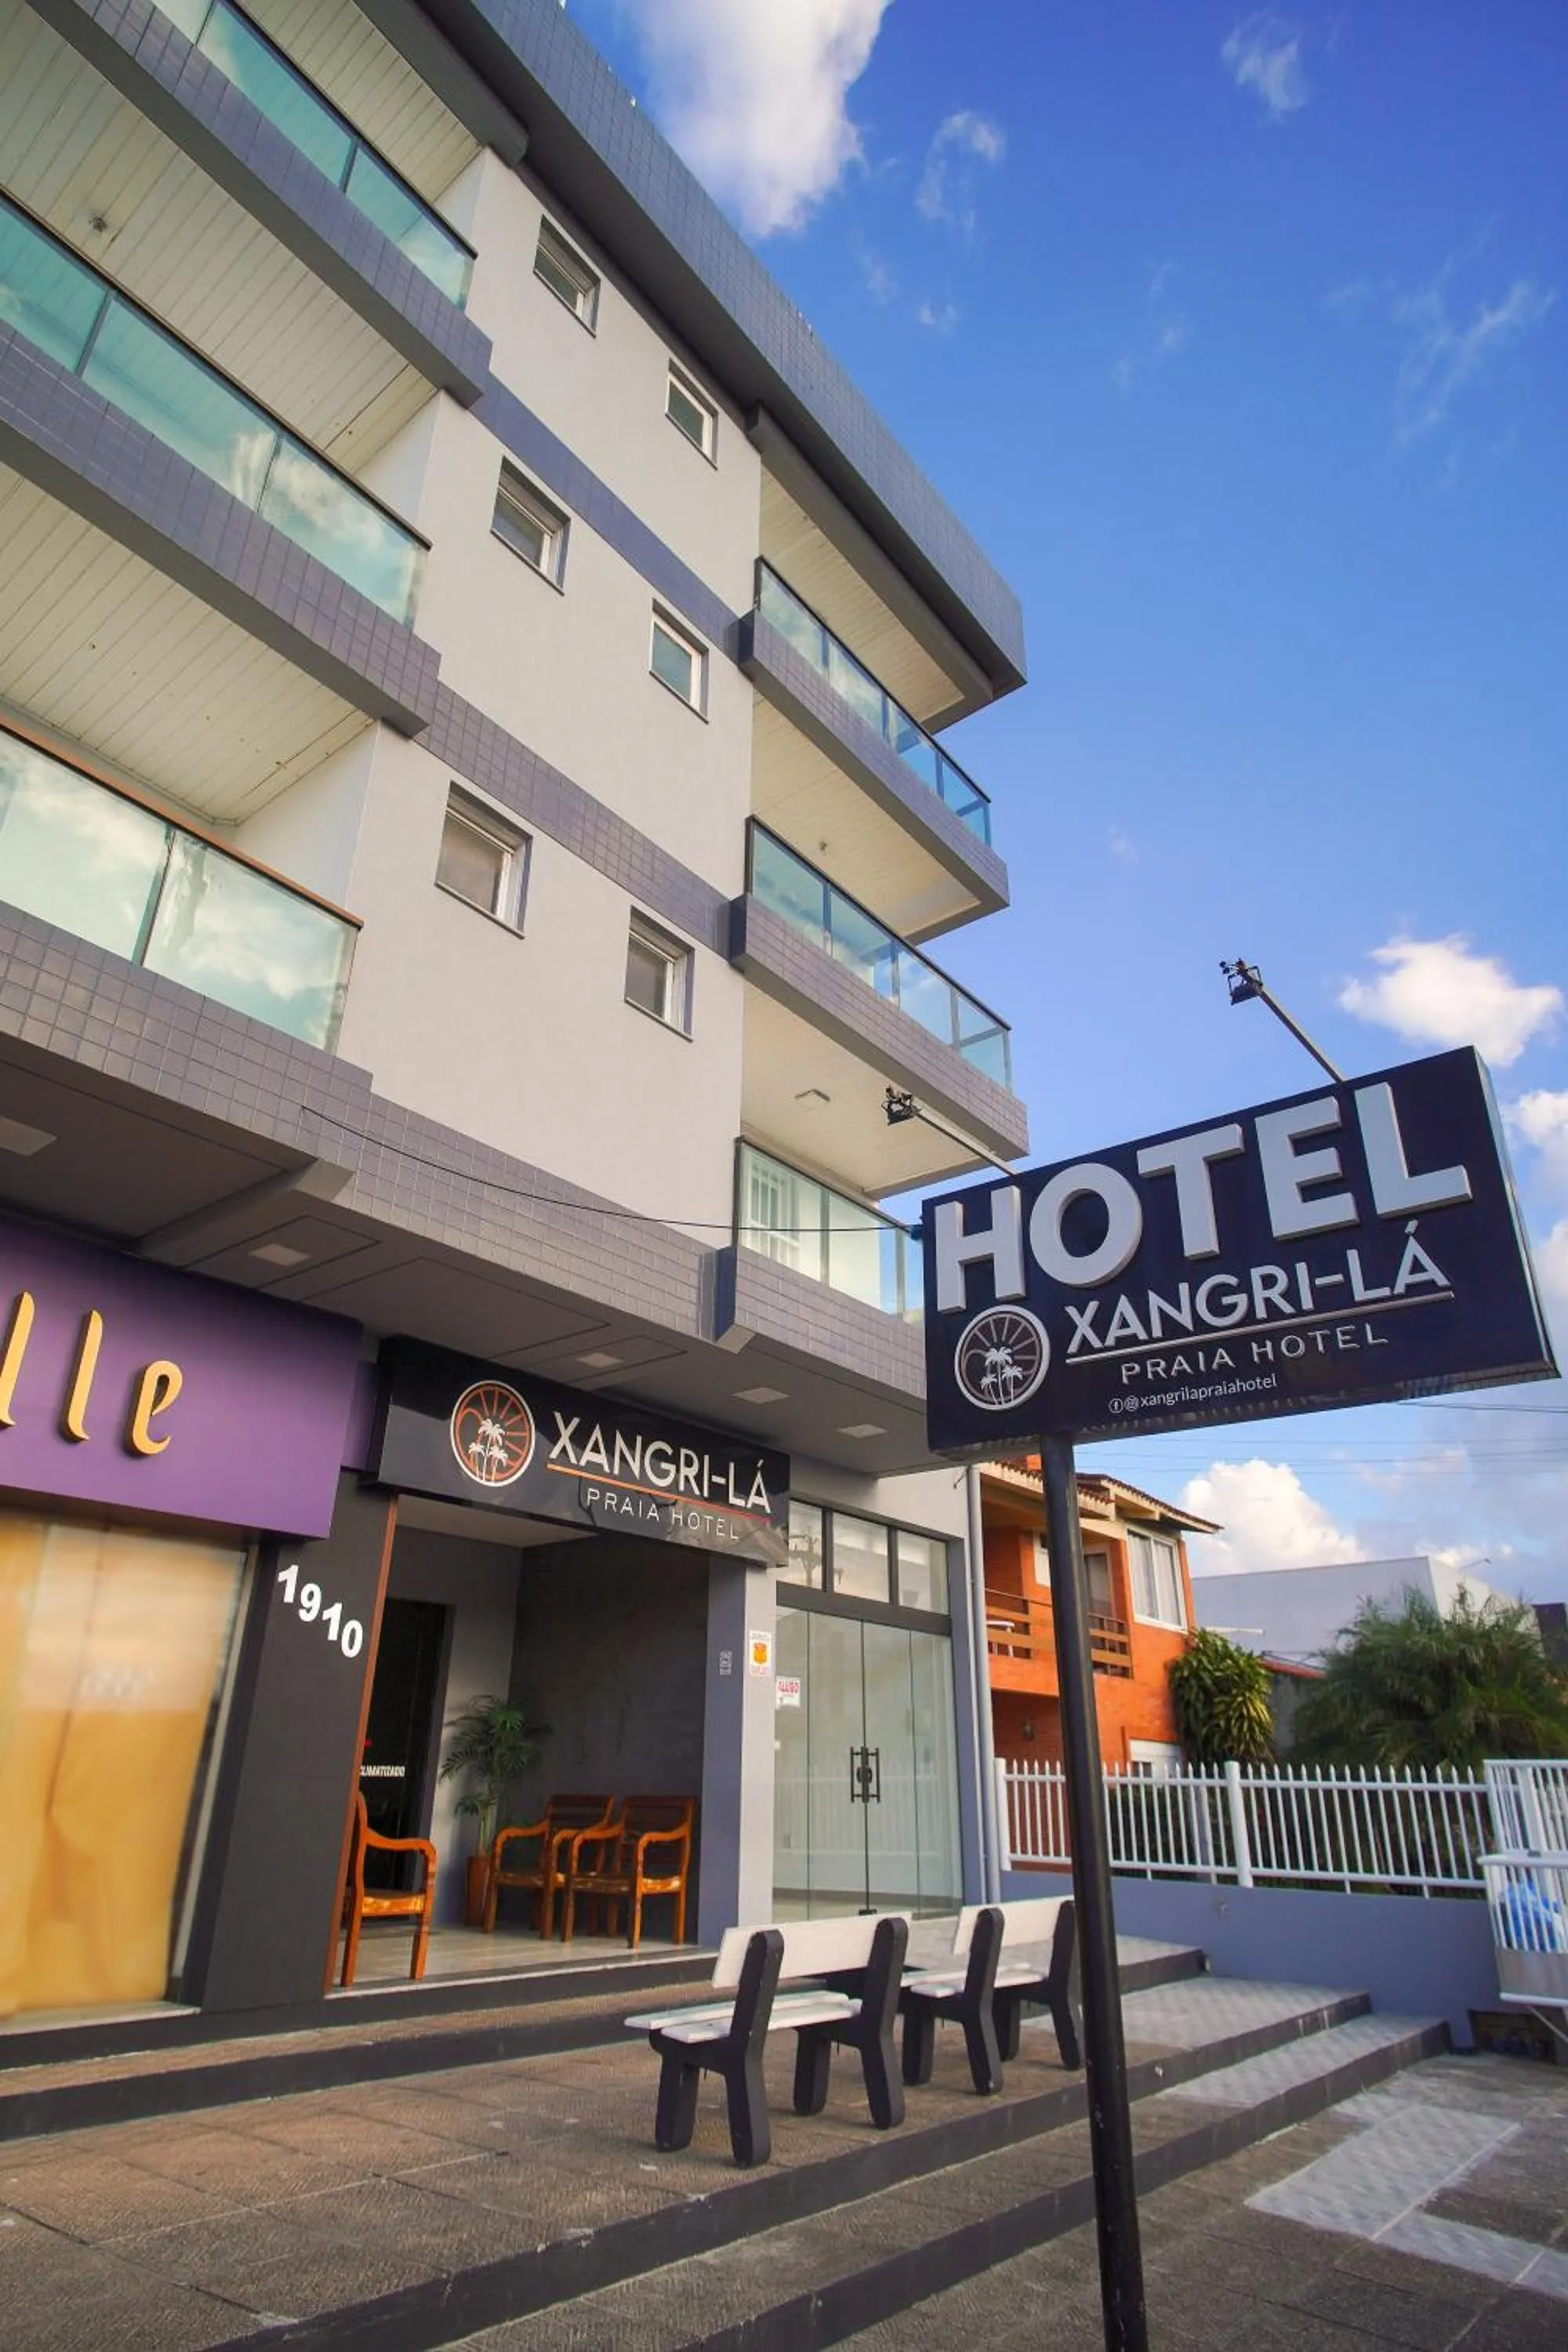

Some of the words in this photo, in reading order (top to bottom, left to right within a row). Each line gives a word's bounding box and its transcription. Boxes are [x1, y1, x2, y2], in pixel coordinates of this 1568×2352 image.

[934, 1082, 1473, 1314] HOTEL
[1065, 1220, 1452, 1355] XANGRI-LÁ
[1120, 1343, 1236, 1385] PRAIA
[1251, 1323, 1389, 1366] HOTEL
[549, 1411, 772, 1514] XANGRI-LÁ
[586, 1487, 661, 1523] PRAIA
[671, 1510, 739, 1541] HOTEL
[277, 1564, 364, 1658] 1910
